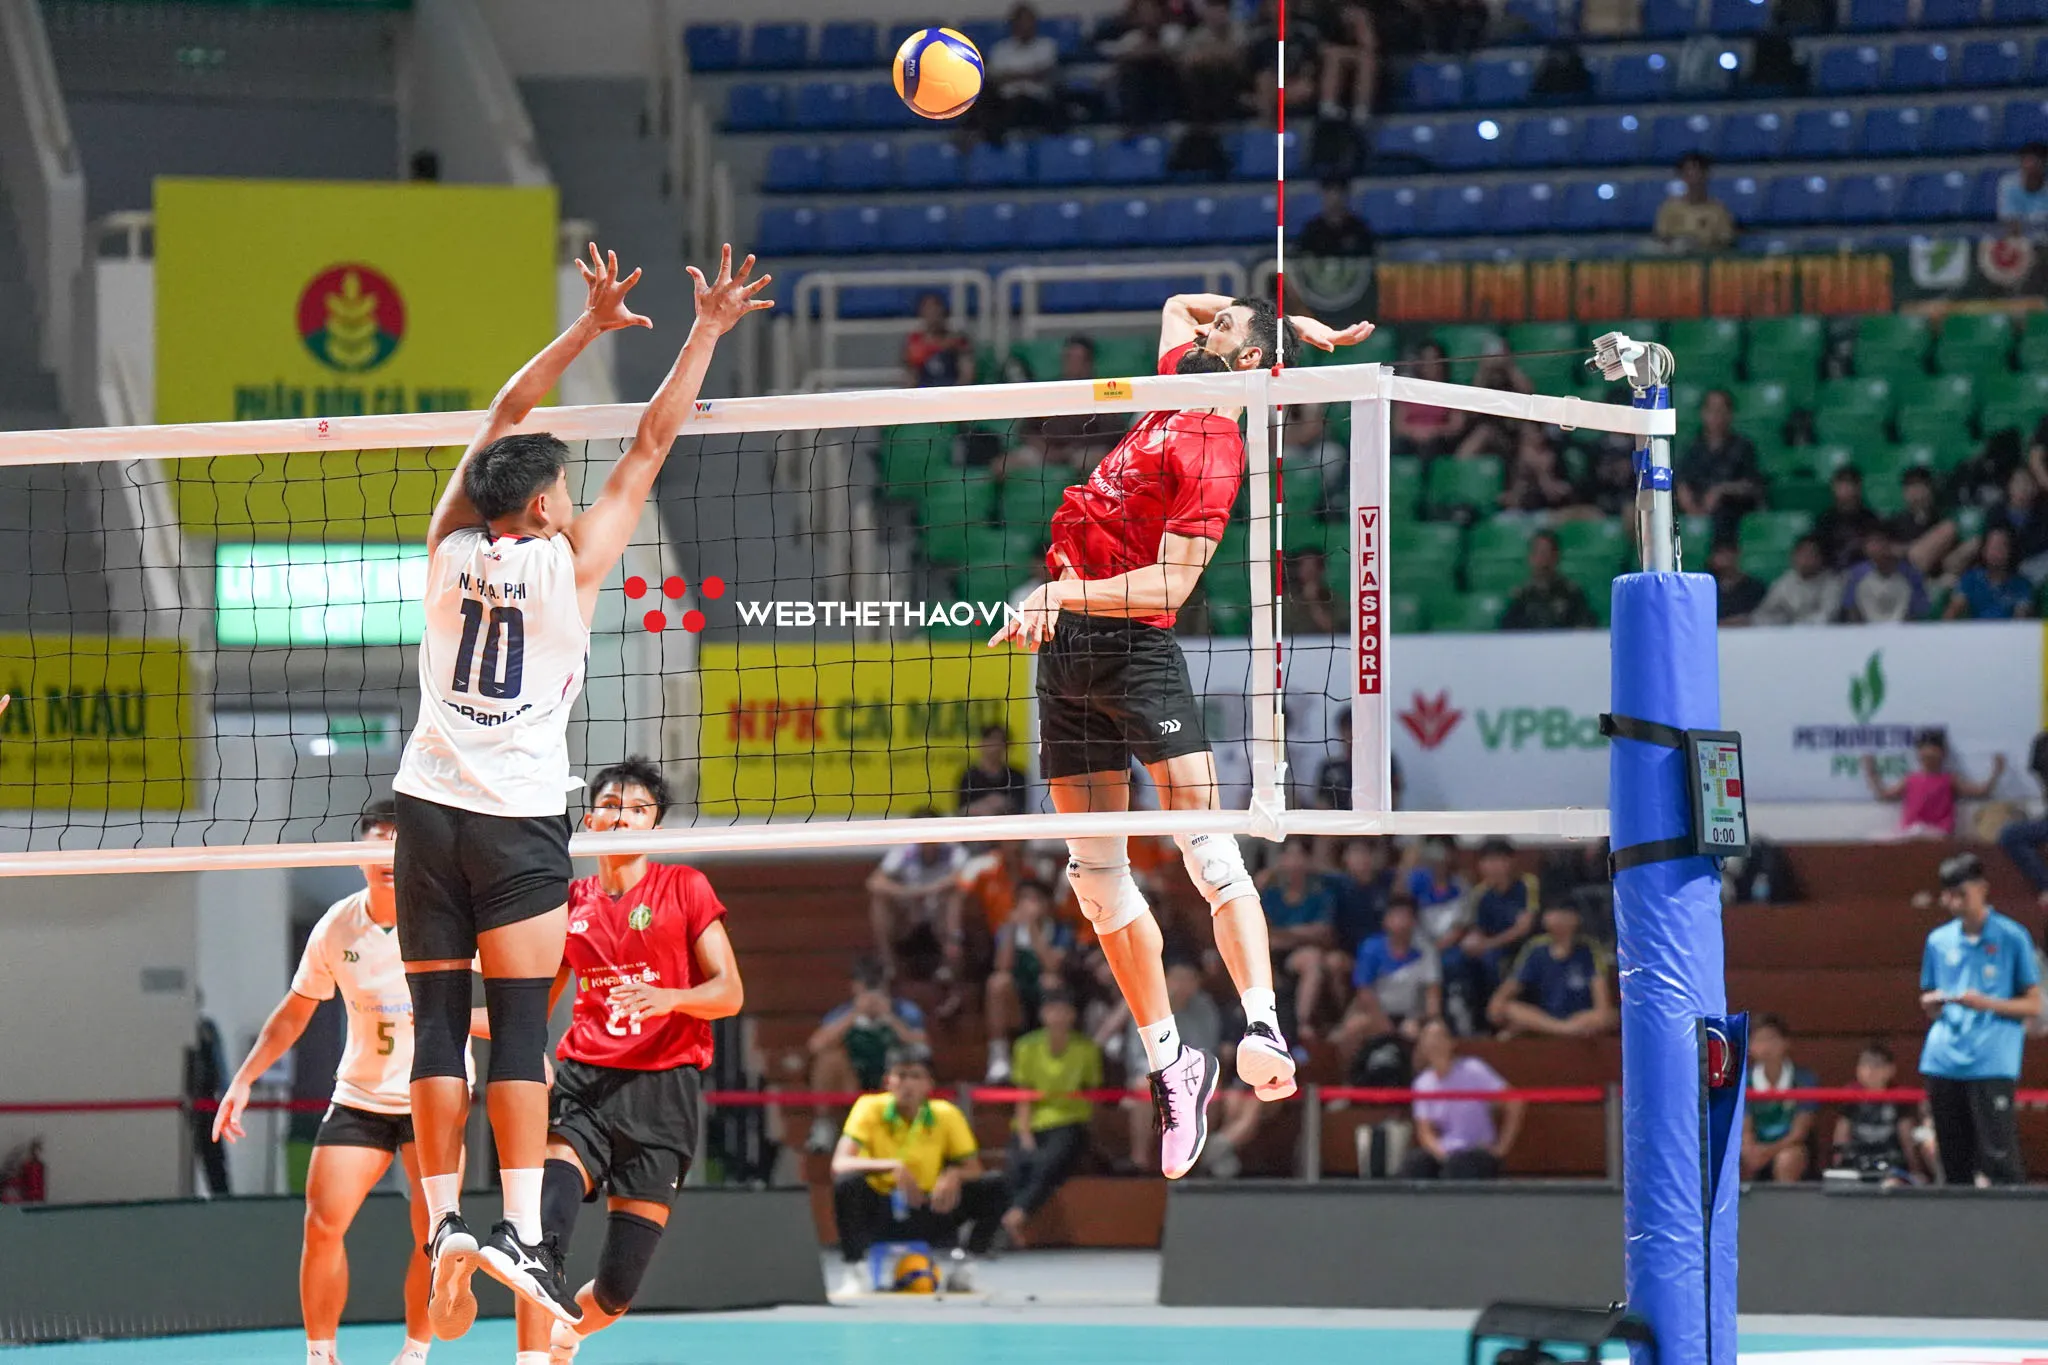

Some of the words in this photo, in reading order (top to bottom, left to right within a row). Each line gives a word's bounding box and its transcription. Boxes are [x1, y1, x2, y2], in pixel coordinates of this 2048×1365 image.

[459, 572, 472, 591] N.
[504, 582, 526, 600] PHI
[452, 598, 524, 699] 10
[1361, 595, 1378, 690] SPORT
[46, 685, 148, 736] MAU
[727, 698, 824, 742] NPK
[1475, 706, 1609, 749] VPBa
[1712, 827, 1735, 843] 0:00
[377, 1021, 396, 1056] 5
